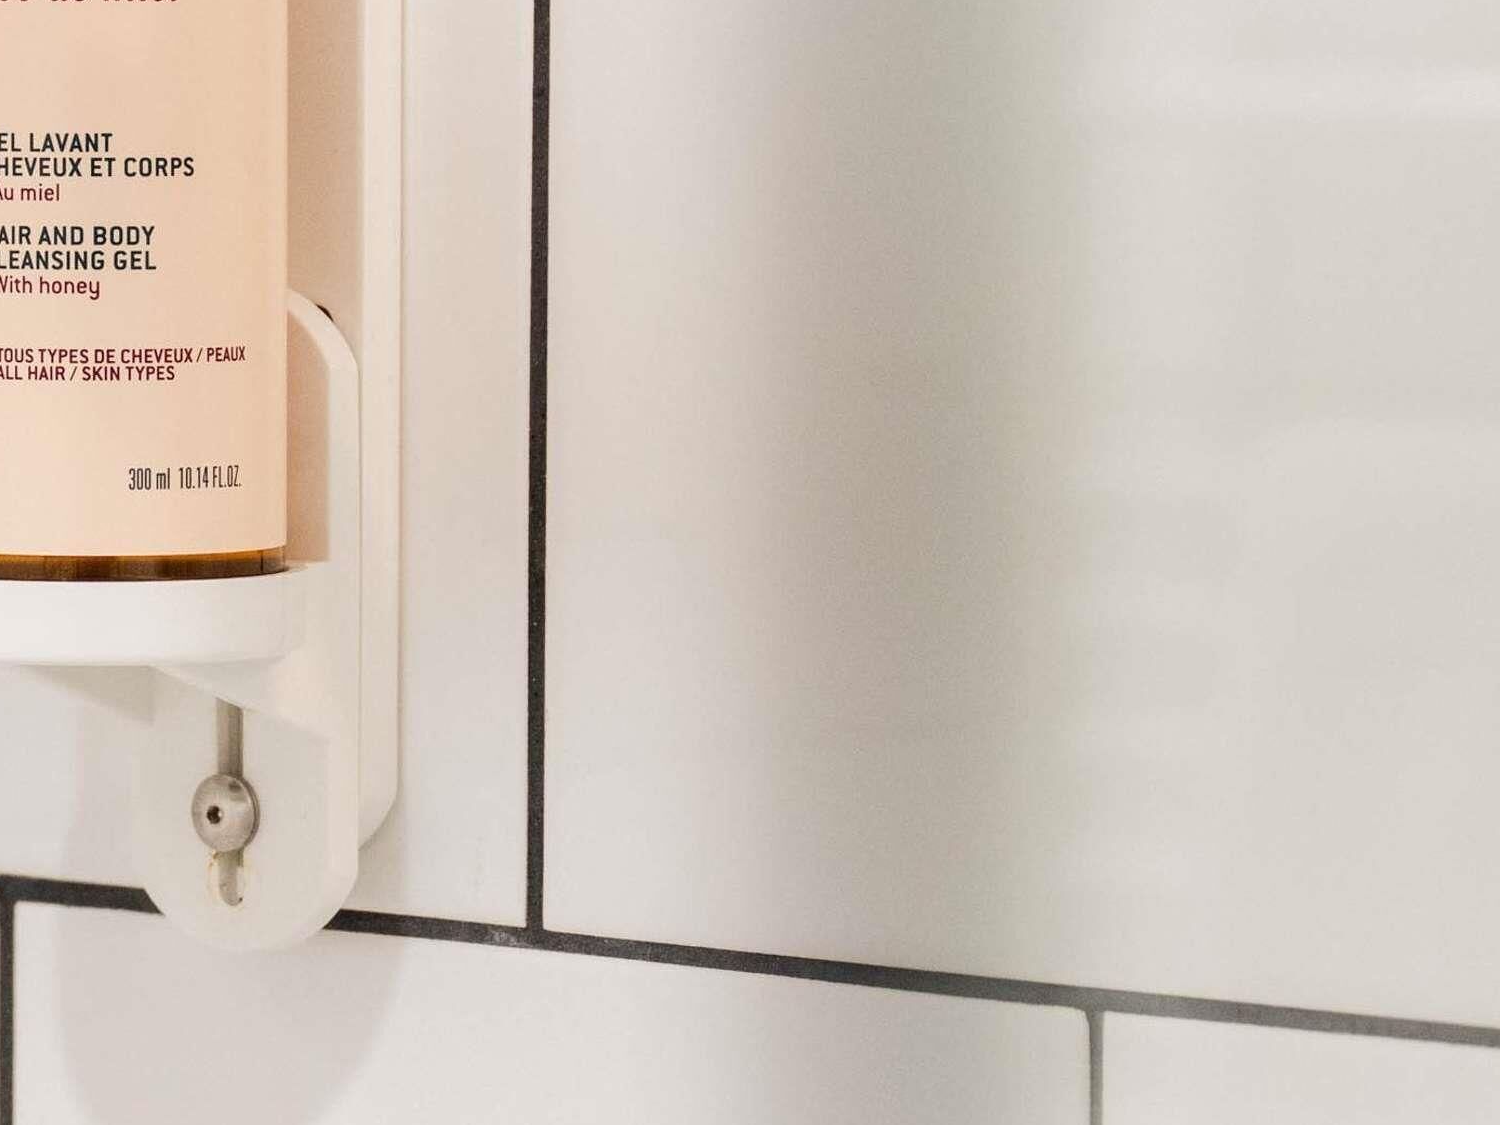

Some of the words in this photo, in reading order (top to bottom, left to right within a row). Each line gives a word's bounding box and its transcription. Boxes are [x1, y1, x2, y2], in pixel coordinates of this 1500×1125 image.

[29, 132, 114, 153] LAVANT
[90, 157, 117, 177] ET
[123, 157, 195, 177] CORPS
[20, 183, 60, 201] miel
[37, 226, 85, 246] AND
[92, 225, 156, 246] BODY
[113, 250, 158, 271] GEL
[39, 276, 101, 301] honey
[38, 348, 90, 365] TYPES
[93, 348, 116, 364] DE
[120, 348, 194, 363] CHEVEUX
[206, 346, 246, 363] PEAUX
[26, 365, 67, 381] HAIR
[81, 366, 121, 381] SKIN
[125, 365, 176, 381] TYPES
[128, 467, 152, 491] 300
[155, 467, 171, 490] ml
[178, 466, 209, 490] 10.14
